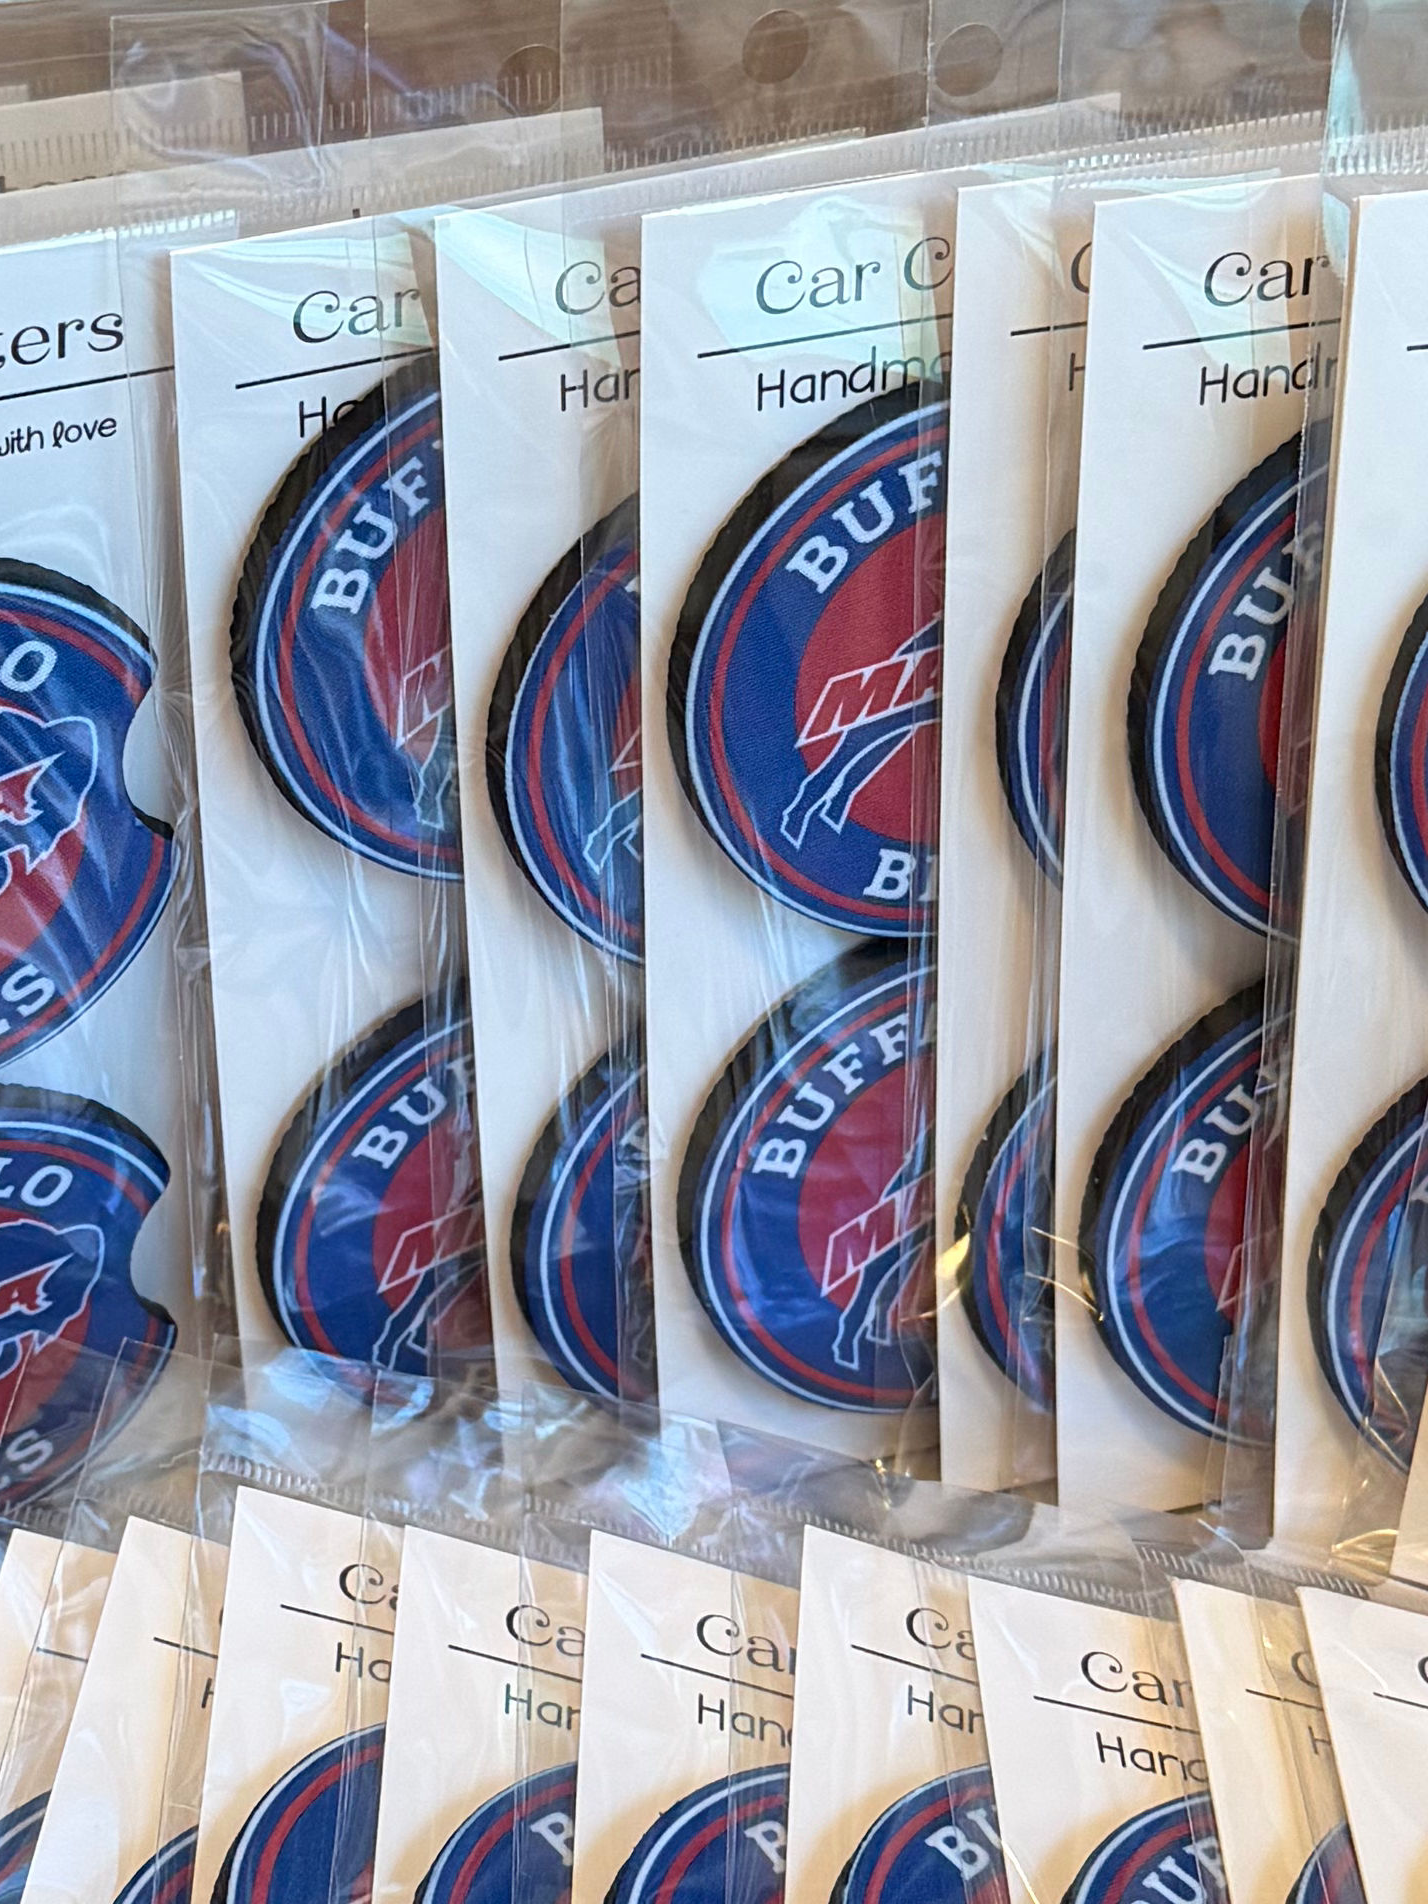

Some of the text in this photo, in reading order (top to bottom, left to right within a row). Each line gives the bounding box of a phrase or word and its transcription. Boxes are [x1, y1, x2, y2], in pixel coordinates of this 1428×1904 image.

[555, 260, 640, 315] Ca
[756, 260, 881, 315] Car
[1204, 252, 1330, 307] Car
[292, 287, 421, 345] Car
[51, 414, 119, 449] love
[753, 1013, 912, 1180] BUFF
[505, 1603, 585, 1659] Ca
